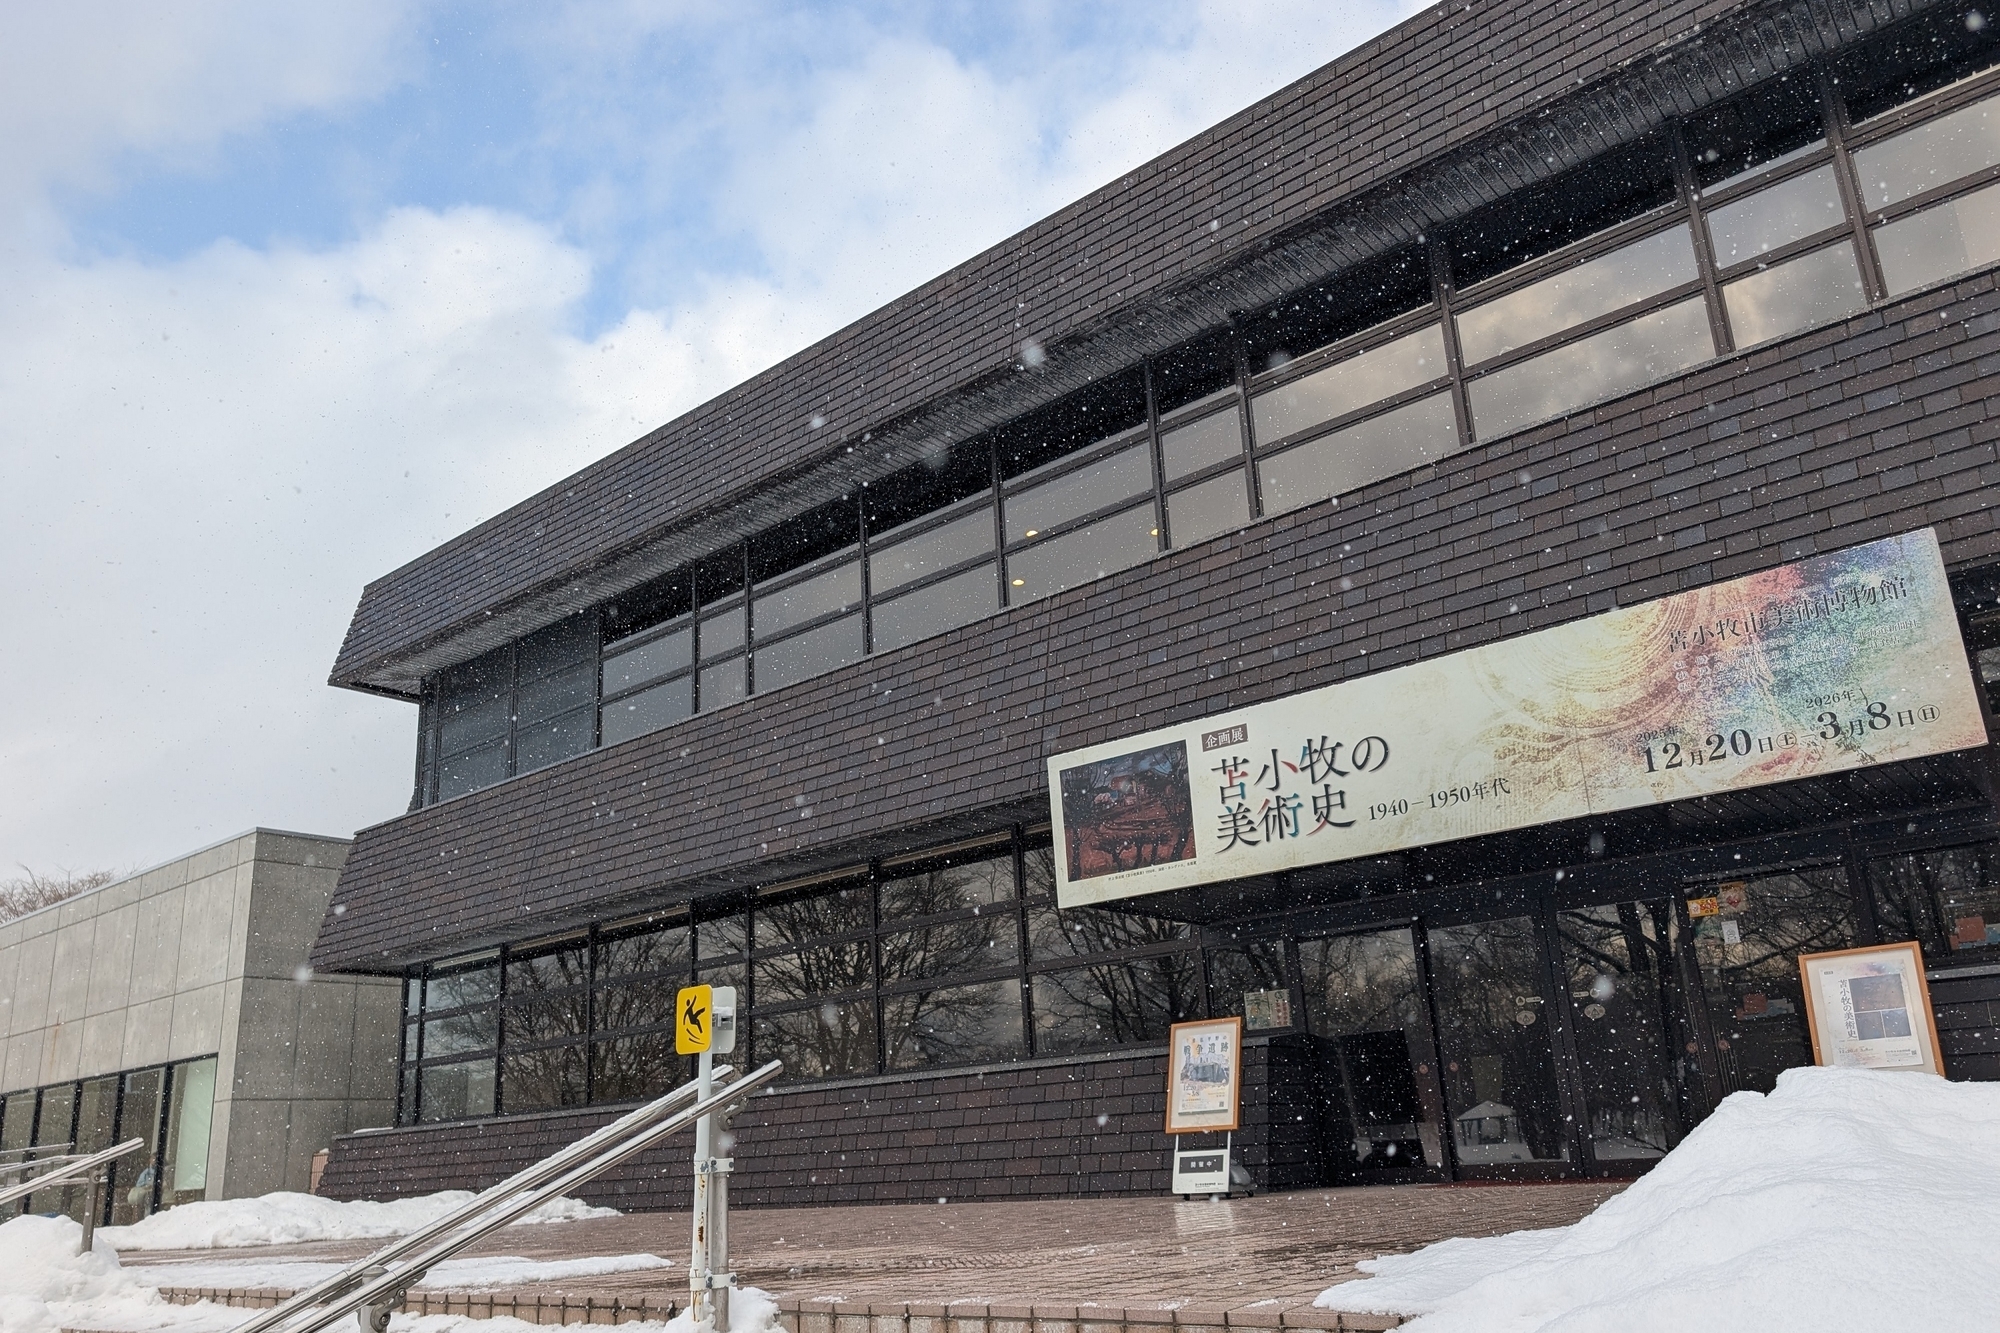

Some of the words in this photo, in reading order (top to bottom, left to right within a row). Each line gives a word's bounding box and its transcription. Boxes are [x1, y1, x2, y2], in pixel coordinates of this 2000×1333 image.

[1668, 576, 1909, 653] 苫小牧市美術博物館
[1805, 690, 1856, 709] 2026年
[1204, 728, 1247, 750] 企画展
[1635, 726, 1680, 743] 2025年
[1211, 735, 1389, 804] 苫小牧の
[1215, 784, 1356, 854] 美術史
[1838, 979, 1858, 1039] 苫小牧の美術史
